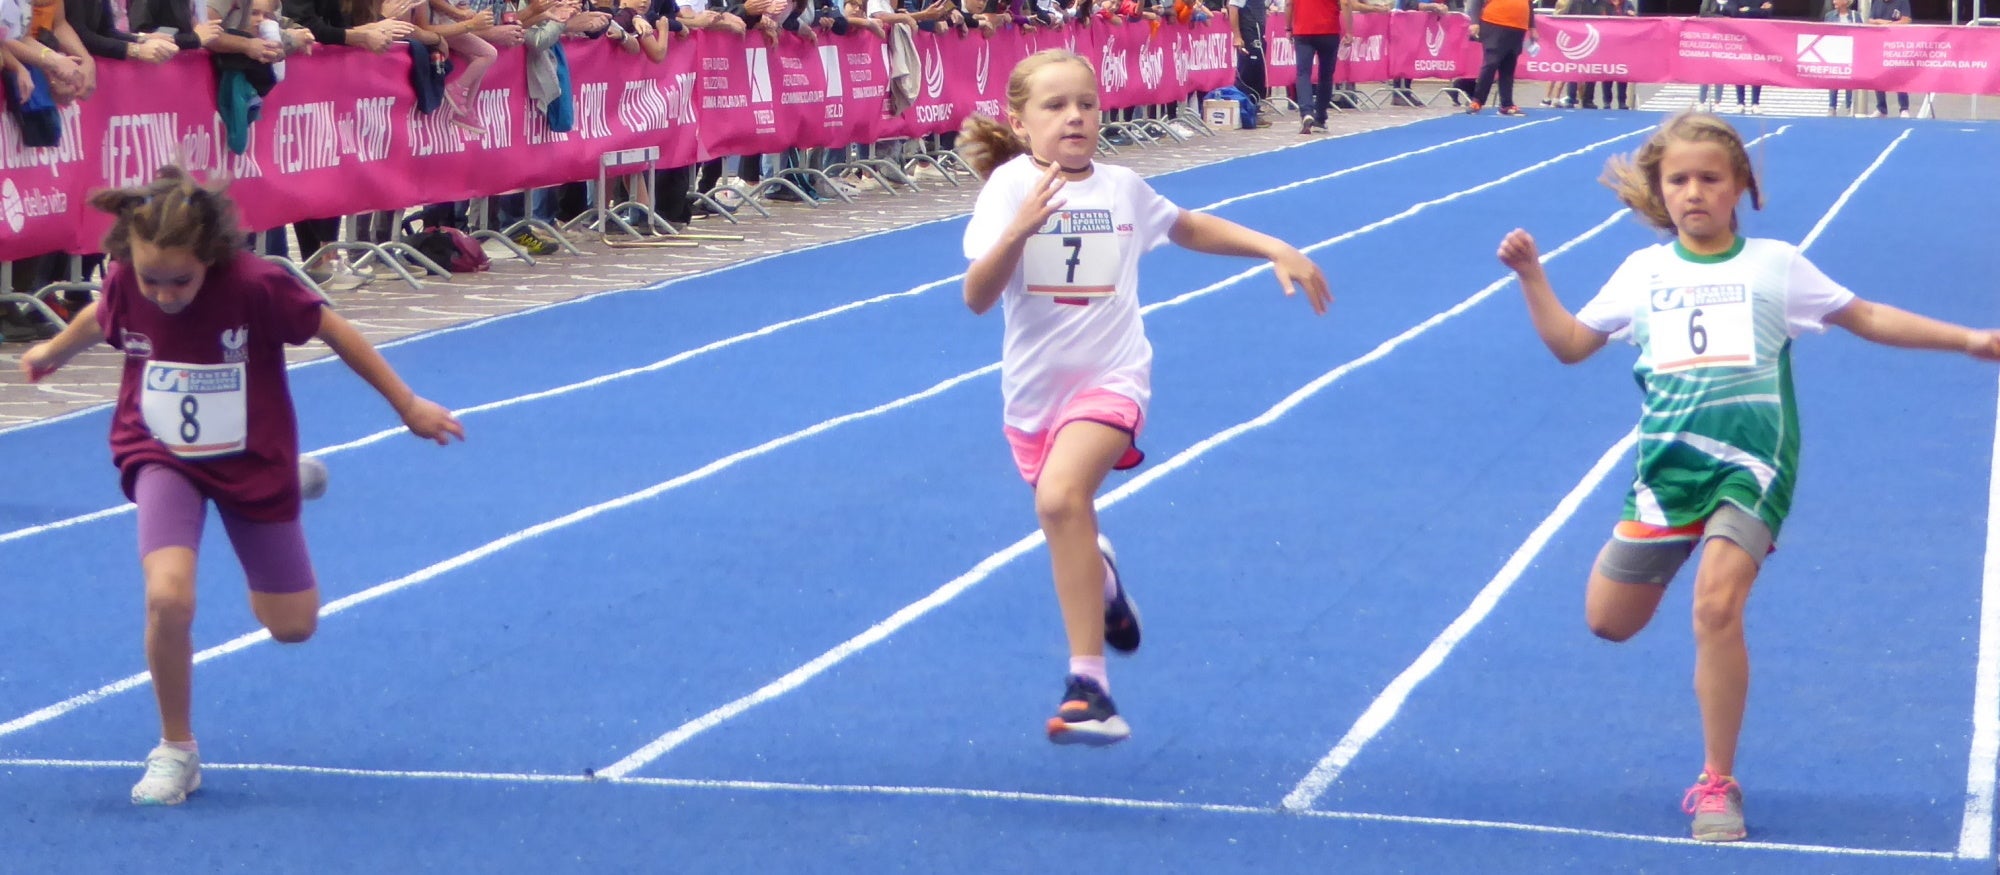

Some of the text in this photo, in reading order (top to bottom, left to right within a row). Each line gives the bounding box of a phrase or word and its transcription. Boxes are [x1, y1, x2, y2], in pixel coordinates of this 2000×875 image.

[1712, 33, 1747, 42] ATLETICA
[1883, 41, 1905, 49] PISTA
[1526, 61, 1629, 75] ECOPNEUS
[1679, 49, 1710, 58] GOMMA
[1767, 55, 1783, 63] PFU
[1796, 64, 1853, 75] TYREFIELD
[1883, 50, 1947, 59] REALIZZATA CON
[1883, 59, 1987, 70] GOMMA RICICLATA DA PFU
[477, 89, 512, 149] SPORT
[580, 83, 612, 140] SPORT
[622, 79, 668, 132] FESTIVAL
[183, 124, 211, 171] dello
[279, 100, 341, 173] FESTIVAL
[356, 97, 396, 162] SPORT
[23, 188, 49, 217] della
[48, 187, 68, 213] vita
[1072, 218, 1111, 226] SPORTIVO
[1062, 236, 1082, 283] 7
[1688, 308, 1708, 355] 6
[180, 394, 200, 444] 8
